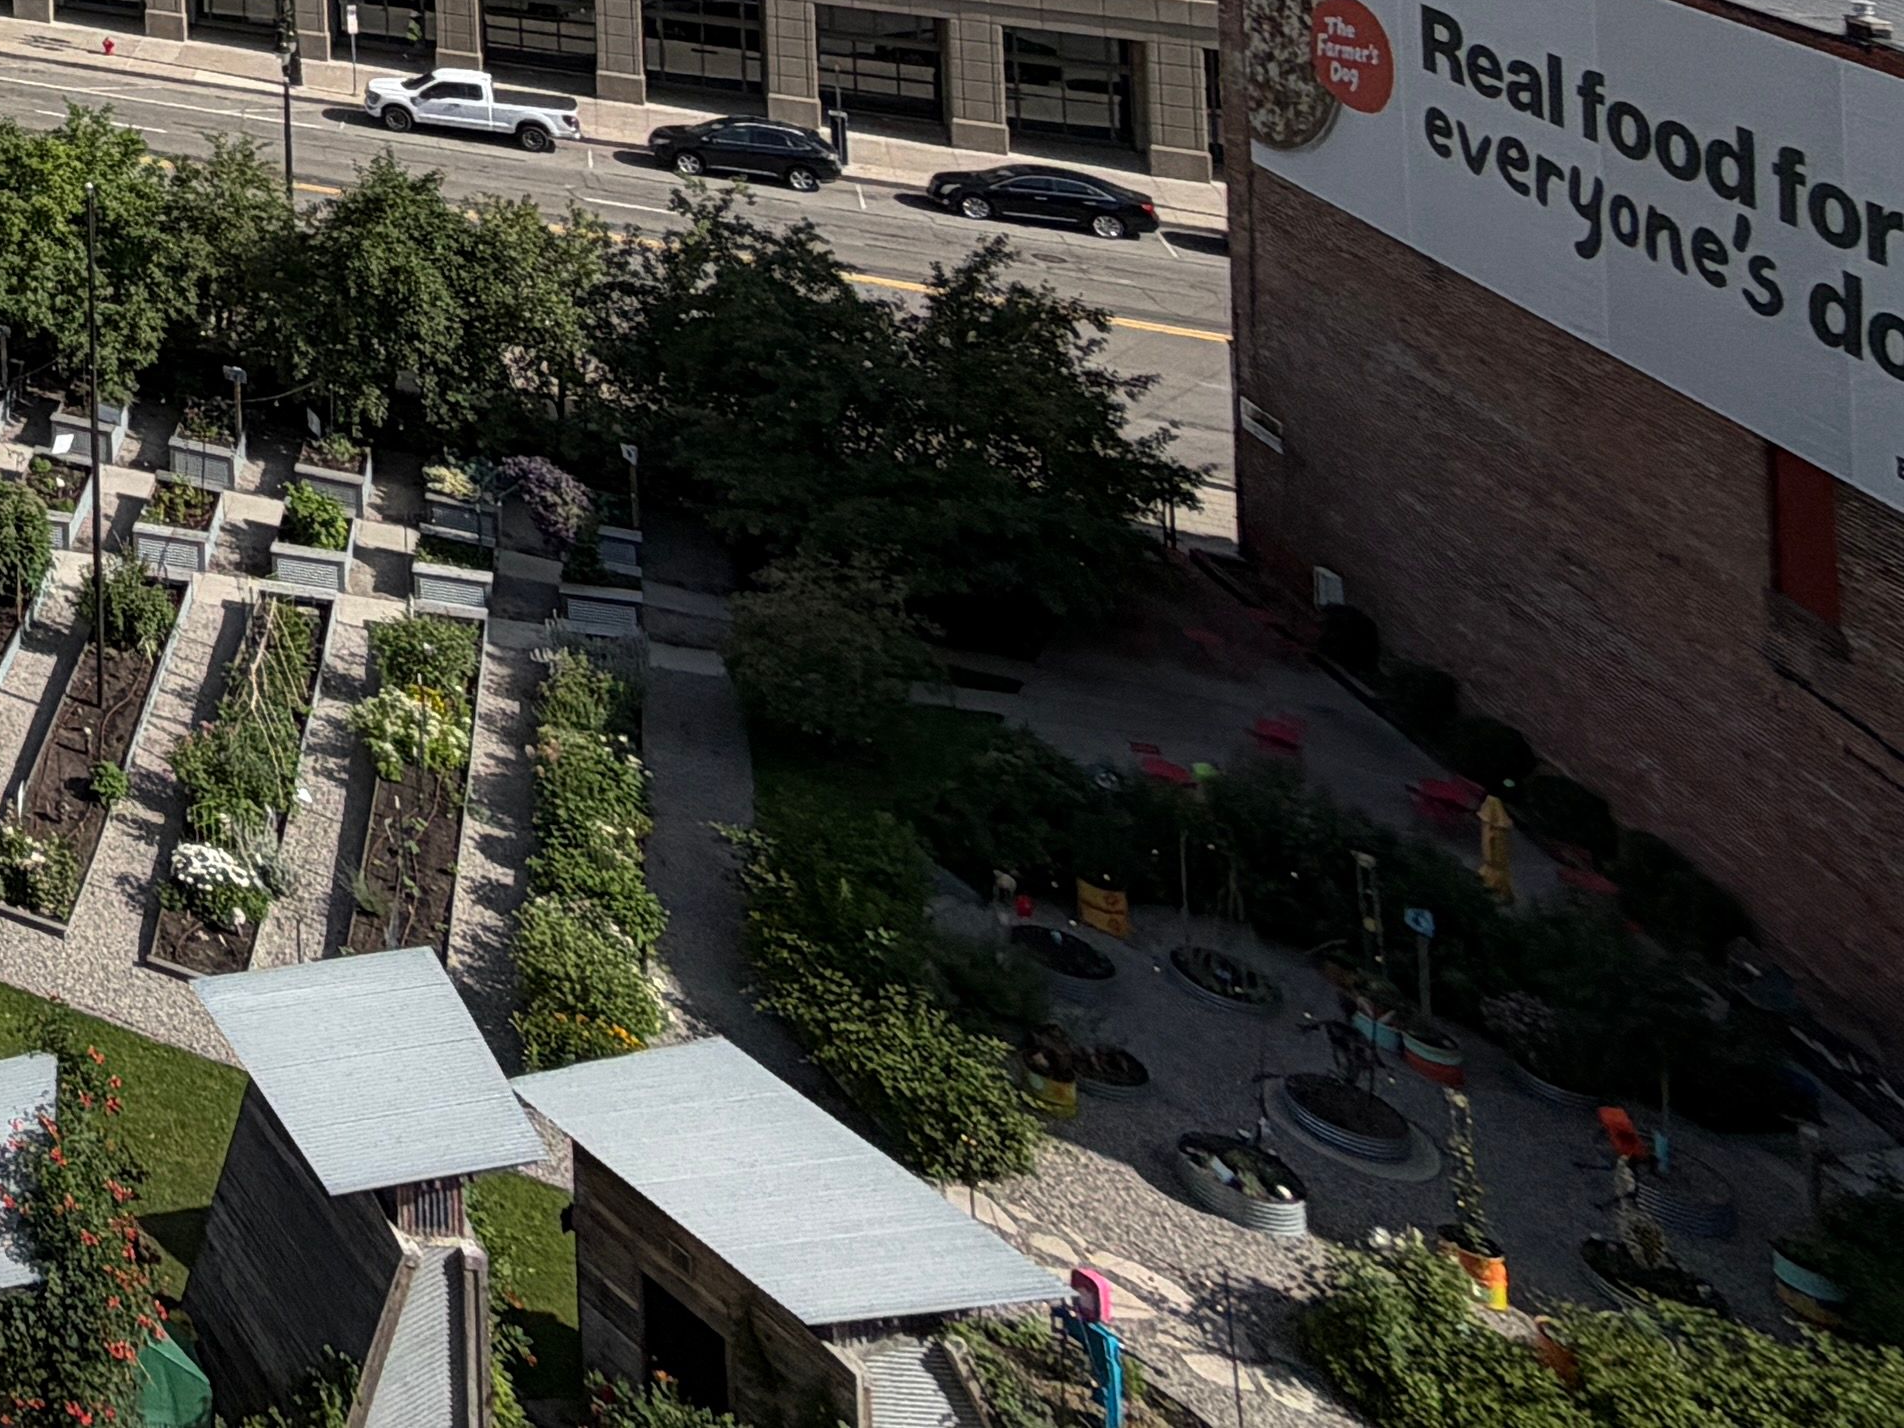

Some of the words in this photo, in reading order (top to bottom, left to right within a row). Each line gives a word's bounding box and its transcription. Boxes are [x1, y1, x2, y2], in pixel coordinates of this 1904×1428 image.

[1324, 16, 1355, 38] The
[1317, 33, 1379, 65] Farmer's
[1330, 60, 1359, 92] Dog
[1420, 3, 1565, 129] Real
[1576, 69, 1757, 210] food
[1772, 146, 1904, 267] for
[1424, 107, 1784, 317] everyone's
